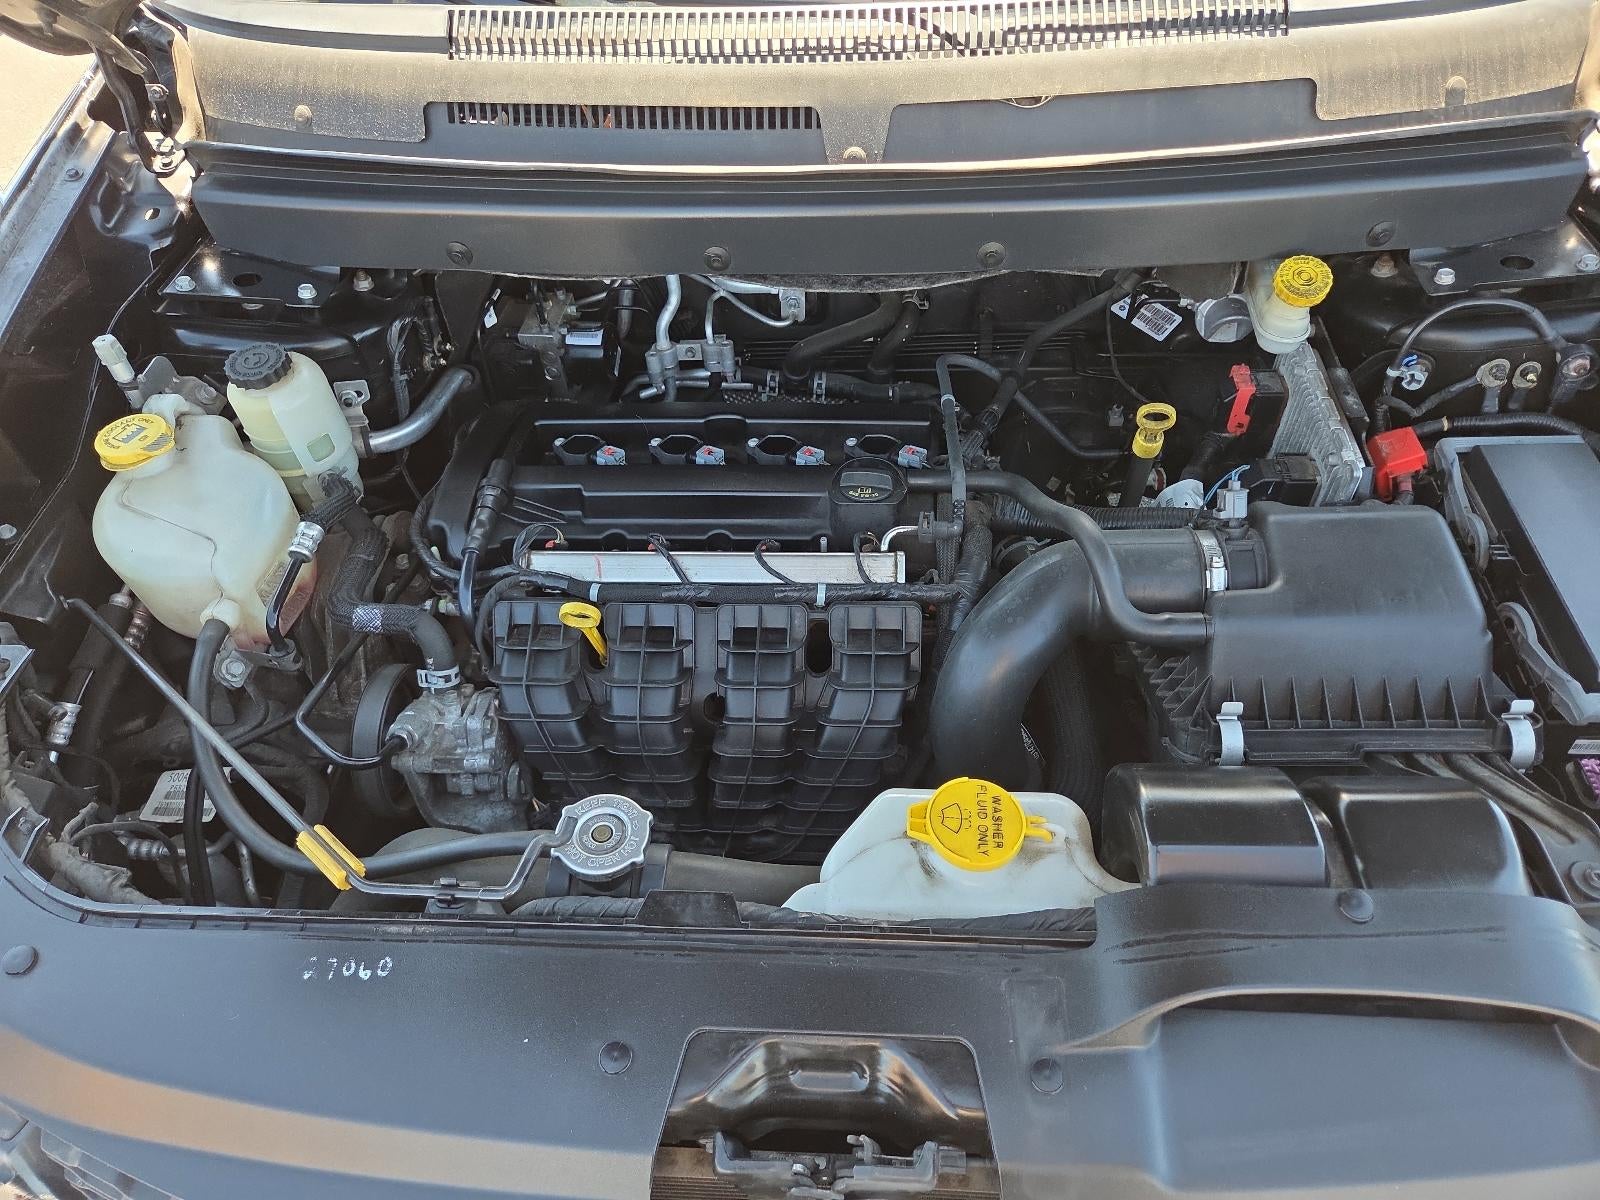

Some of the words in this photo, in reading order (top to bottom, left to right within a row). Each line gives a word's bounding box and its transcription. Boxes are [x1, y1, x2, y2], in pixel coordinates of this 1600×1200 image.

[576, 798, 606, 815] KEEP
[976, 784, 988, 820] FLUID
[992, 795, 1004, 849] WASHER
[587, 853, 621, 867] OPEN
[621, 836, 640, 857] HOT
[977, 824, 989, 857] ONLY
